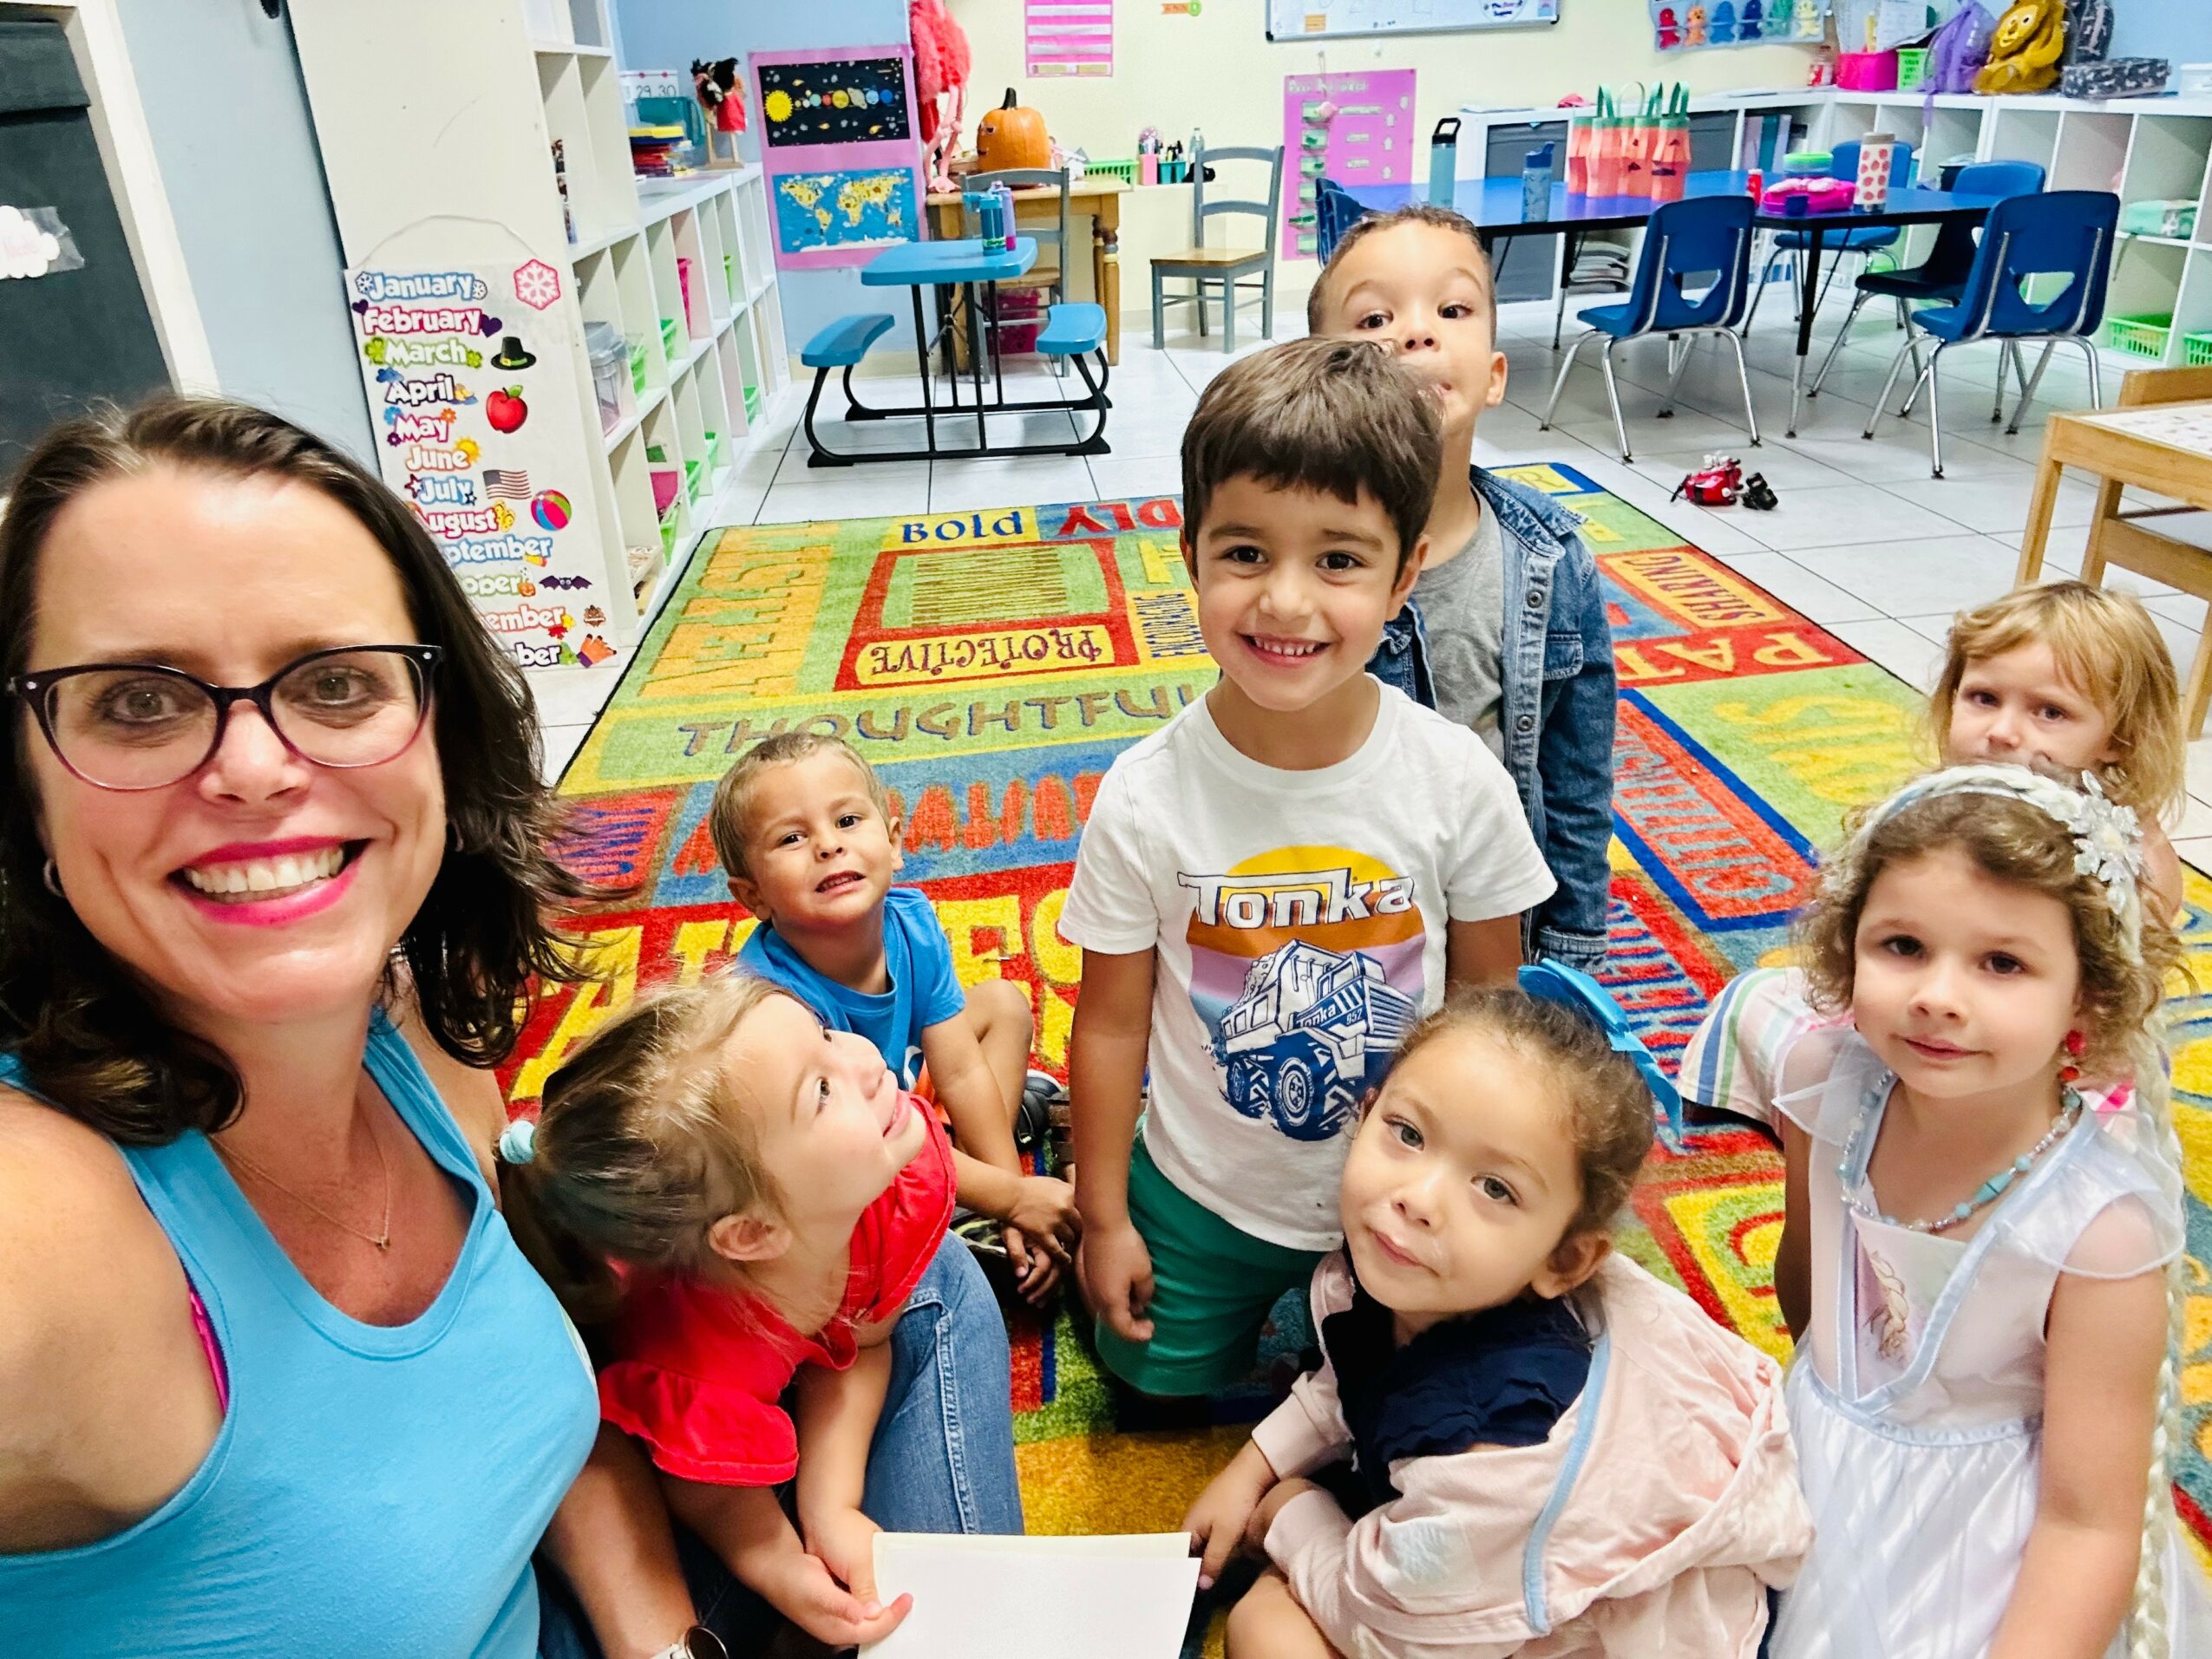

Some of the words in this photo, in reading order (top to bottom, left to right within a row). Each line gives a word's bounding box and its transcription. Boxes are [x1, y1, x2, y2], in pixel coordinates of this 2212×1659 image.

[370, 272, 474, 302] January
[363, 305, 482, 336] February
[384, 337, 467, 368] March
[384, 373, 455, 407] April
[395, 414, 448, 443] May
[405, 445, 472, 471] June
[419, 475, 474, 505] July
[418, 506, 499, 539] ugust
[442, 534, 553, 571] ptember
[1622, 555, 1765, 621] SHARING
[487, 604, 566, 631] ember
[870, 630, 1103, 676] PROTECTIVE
[1177, 867, 1415, 929] Tonka
[1346, 1008, 1363, 1026] 952
